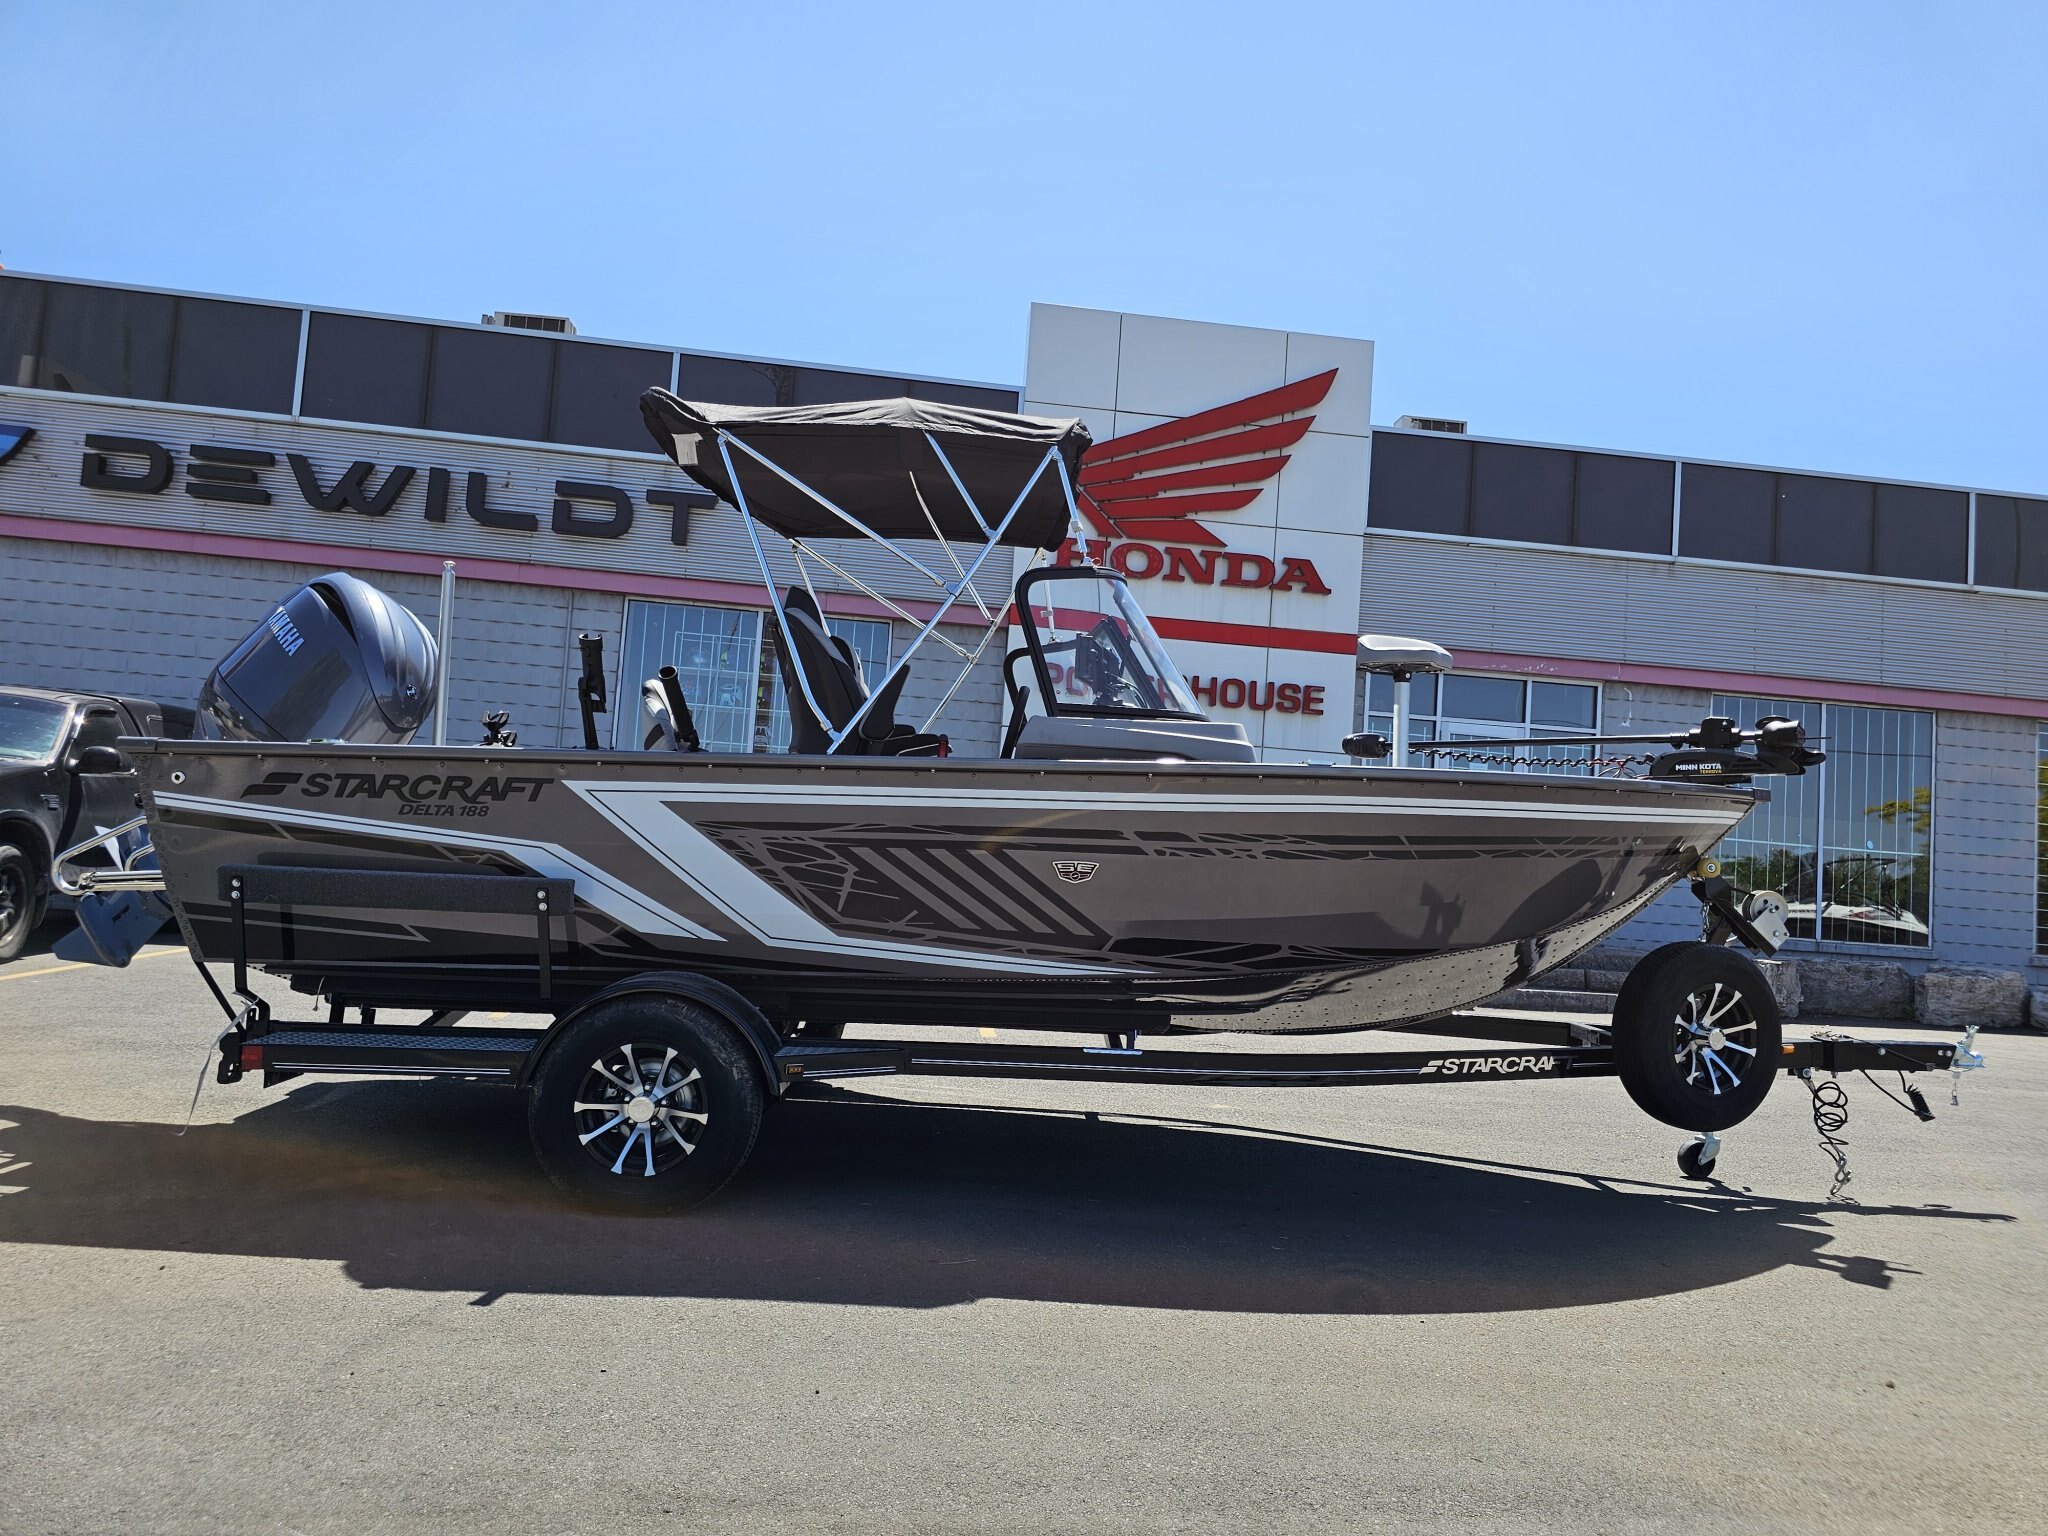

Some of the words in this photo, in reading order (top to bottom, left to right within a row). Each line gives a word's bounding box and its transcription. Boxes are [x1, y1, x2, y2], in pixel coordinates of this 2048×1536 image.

[80, 433, 719, 546] DEWILDT
[1051, 536, 1332, 595] HONDA
[268, 605, 305, 657] YAMAHA
[1046, 662, 1326, 716] POHOUSE
[301, 772, 555, 804] STARCRAFT
[1675, 763, 1698, 771] MINN
[1699, 762, 1722, 770] KOTA
[398, 803, 456, 817] DELTA
[459, 804, 490, 818] 188
